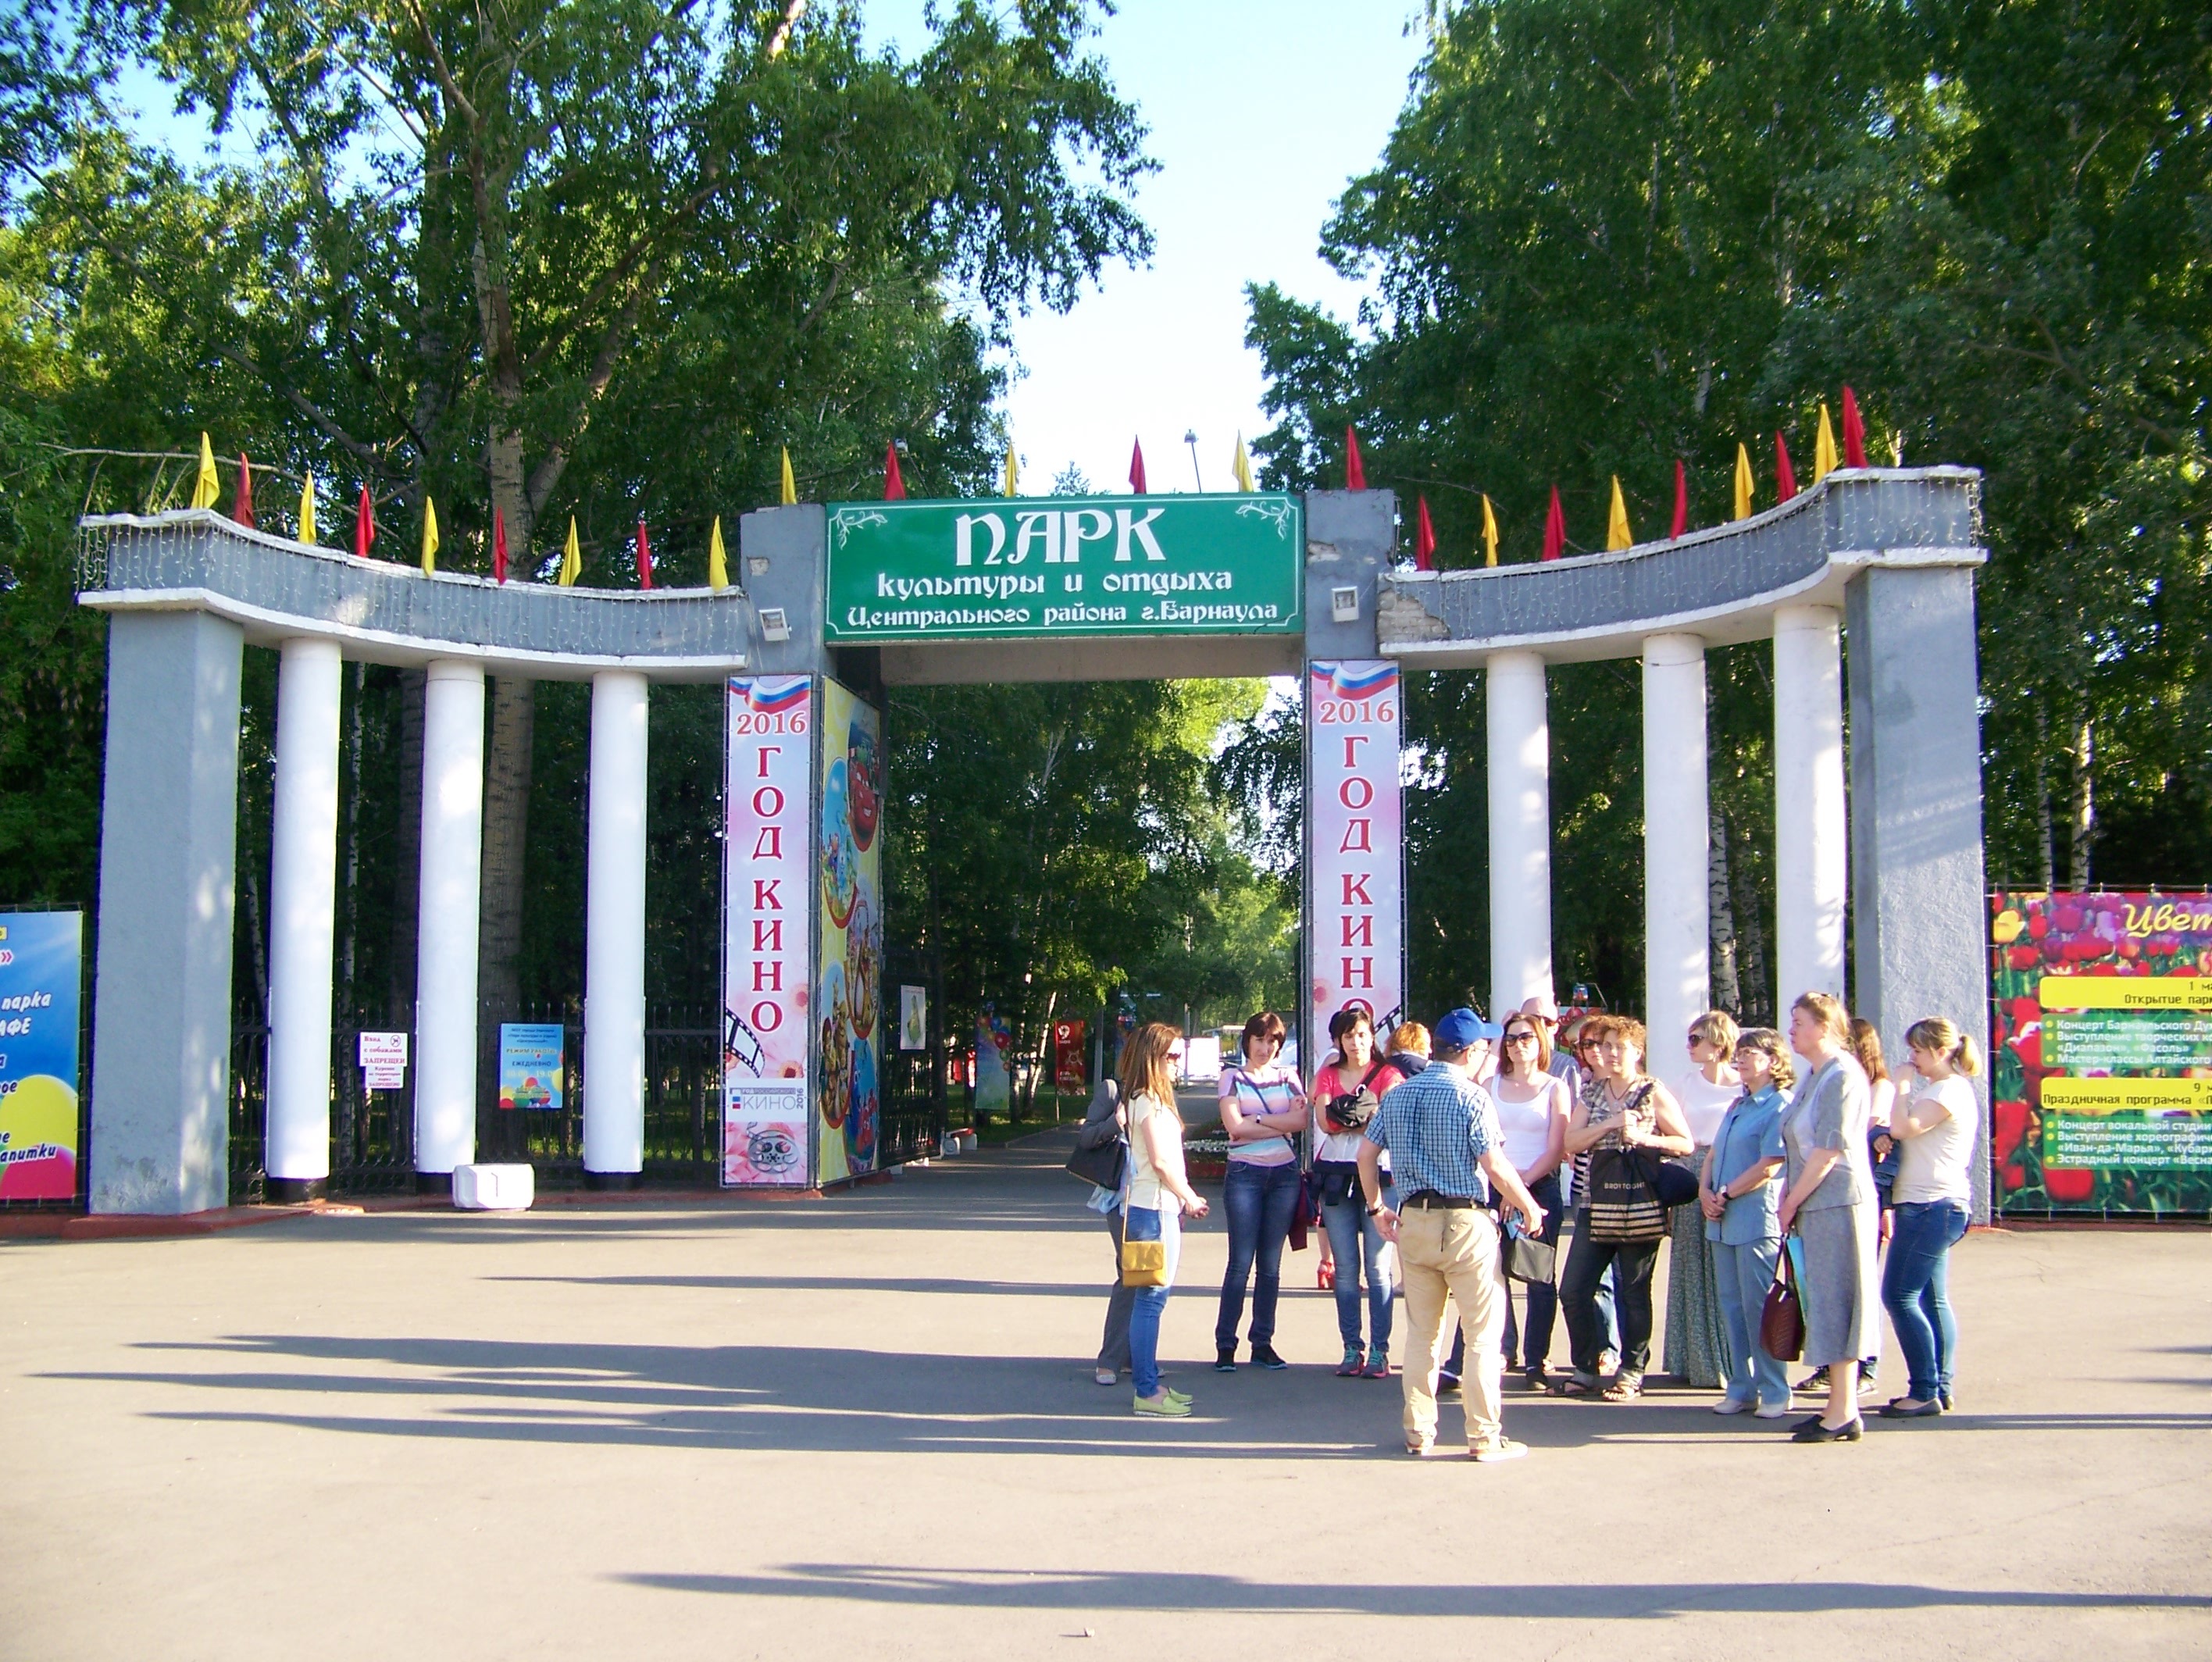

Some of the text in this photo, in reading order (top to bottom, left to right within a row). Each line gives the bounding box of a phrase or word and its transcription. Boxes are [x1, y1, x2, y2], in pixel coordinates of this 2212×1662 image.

[955, 508, 1166, 566] ПАРК
[878, 571, 1233, 601] культуры и отдыха
[847, 601, 1278, 629] Центрального района г.Барнаула
[1320, 701, 1394, 723] 2016
[737, 712, 806, 735] 2016
[1339, 736, 1373, 854] ГОД
[751, 747, 784, 1033] ГОД КИНО
[2189, 982, 2194, 991] 1
[2, 990, 52, 1013] парка
[2125, 994, 2182, 1005] Открытие
[2057, 1020, 2104, 1032] Концерт
[2107, 1020, 2191, 1031] Барнаульского
[2057, 1032, 2132, 1043] Выступление
[2135, 1033, 2202, 1043] творческих
[2057, 1053, 2210, 1065] Мастер-классы Алтайского
[2193, 1083, 2200, 1092] 9
[743, 1096, 796, 1110] КИНО
[2043, 1094, 2120, 1105] Праздничная
[2127, 1096, 2192, 1106] программа
[2057, 1120, 2211, 1132] Концерт вокальной студии
[2057, 1132, 2212, 1143] Выступление хореографич
[2057, 1155, 2120, 1165] Эстрадный
[2123, 1156, 2170, 1166] концерт
